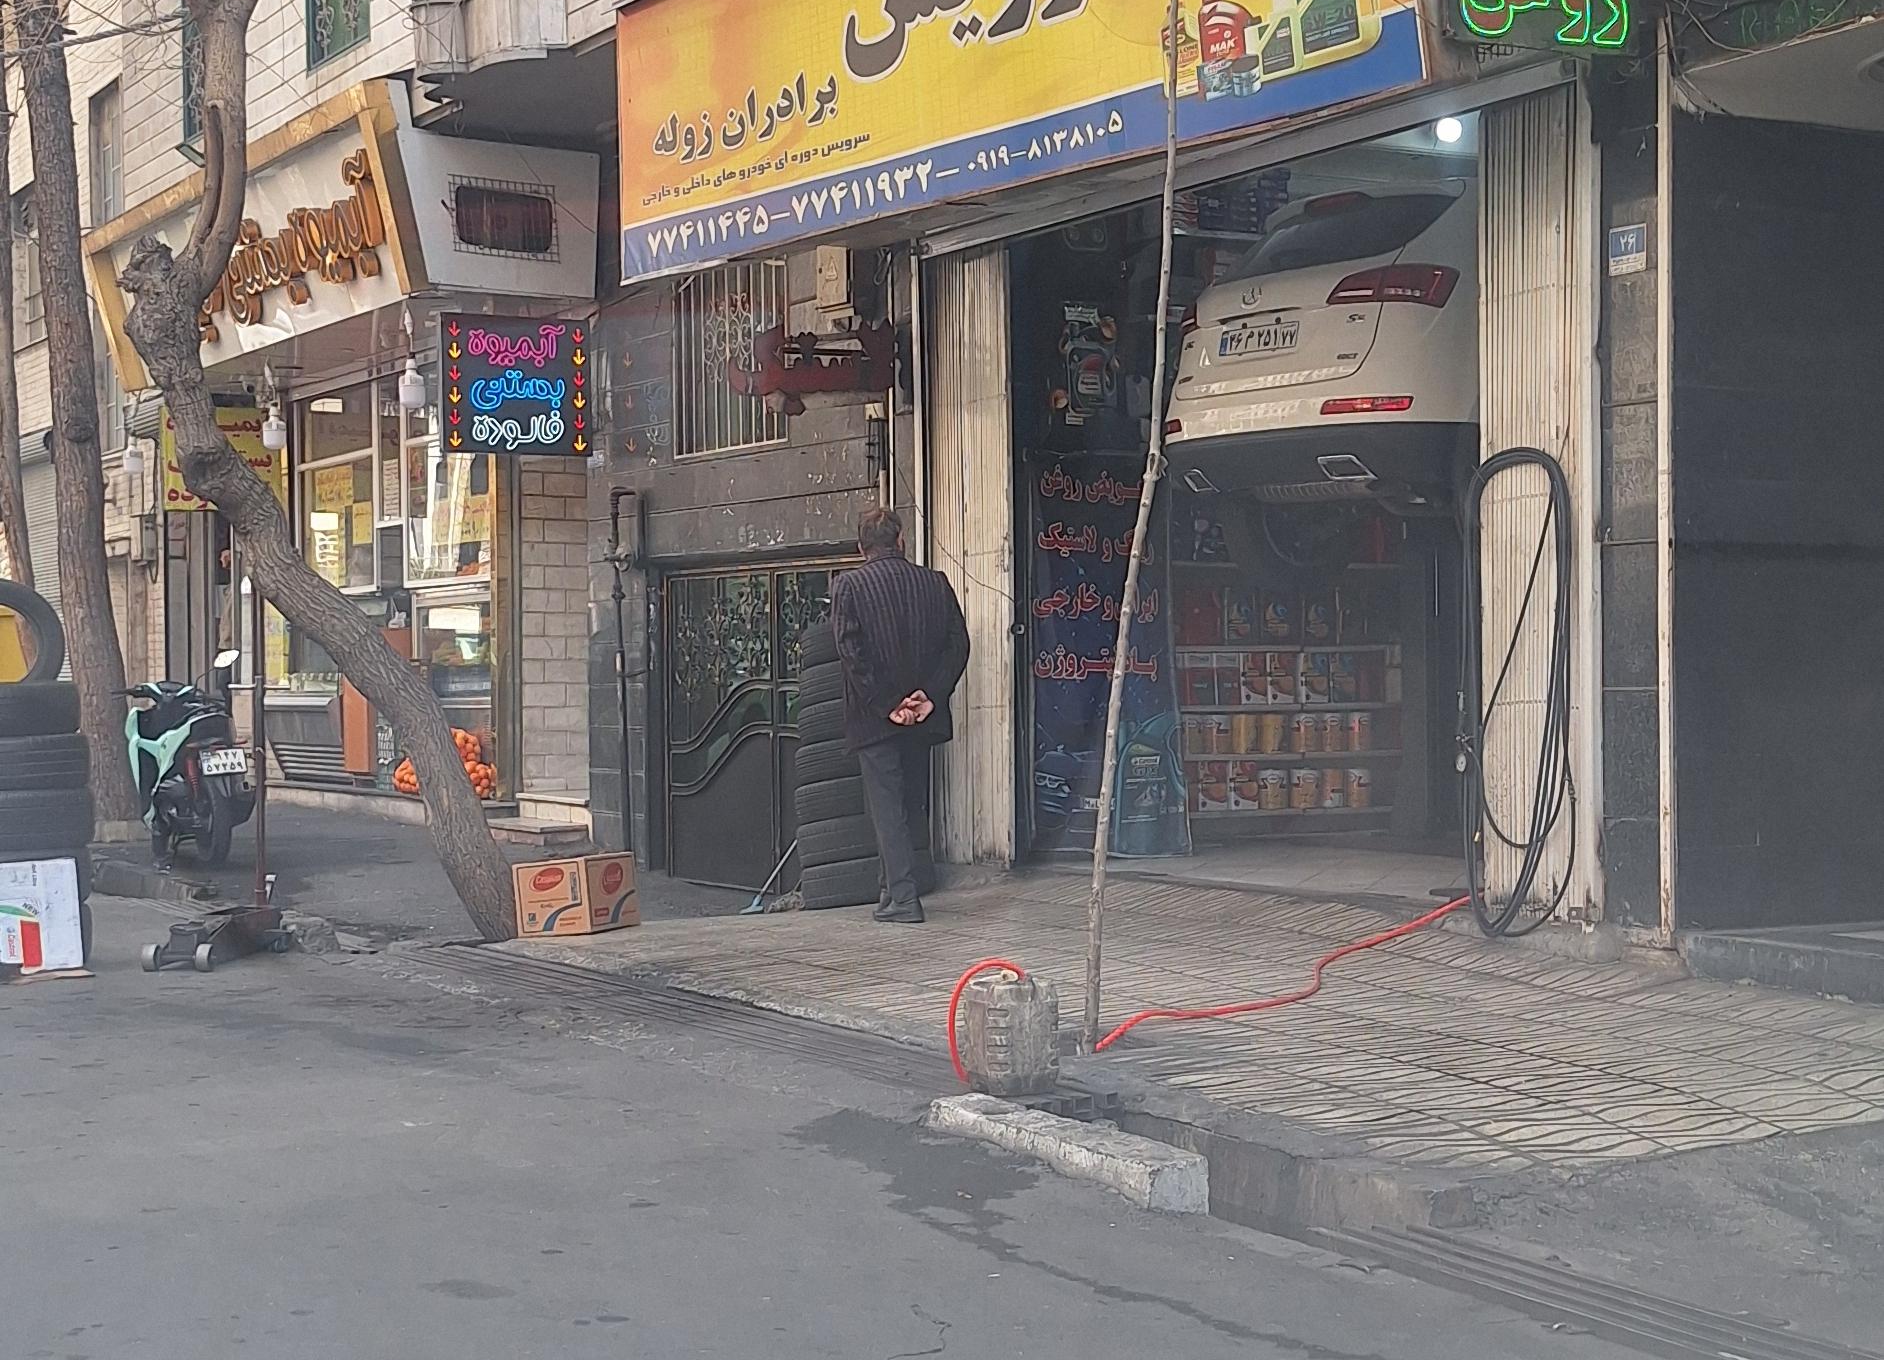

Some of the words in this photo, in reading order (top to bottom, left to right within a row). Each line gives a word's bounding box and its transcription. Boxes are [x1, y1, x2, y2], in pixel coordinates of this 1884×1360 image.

[1209, 37, 1238, 54] MAK
[721, 71, 839, 150] برادران
[653, 112, 713, 162] زوله
[821, 133, 870, 157] سرویس
[775, 151, 788, 170] ای
[791, 148, 818, 163] دوره
[713, 169, 737, 188] های
[739, 159, 772, 179] خودرو
[643, 185, 671, 206] خارجی
[674, 187, 680, 198] و
[682, 174, 710, 195] داخلی
[468, 324, 566, 367] آبمیوه
[470, 370, 566, 410] بستنی
[472, 410, 565, 451] فالوده
[1041, 464, 1083, 501] روغن
[1038, 522, 1097, 557] لاستیک
[1101, 537, 1113, 562] و
[1032, 583, 1101, 618] خارجی
[1102, 595, 1114, 621] و
